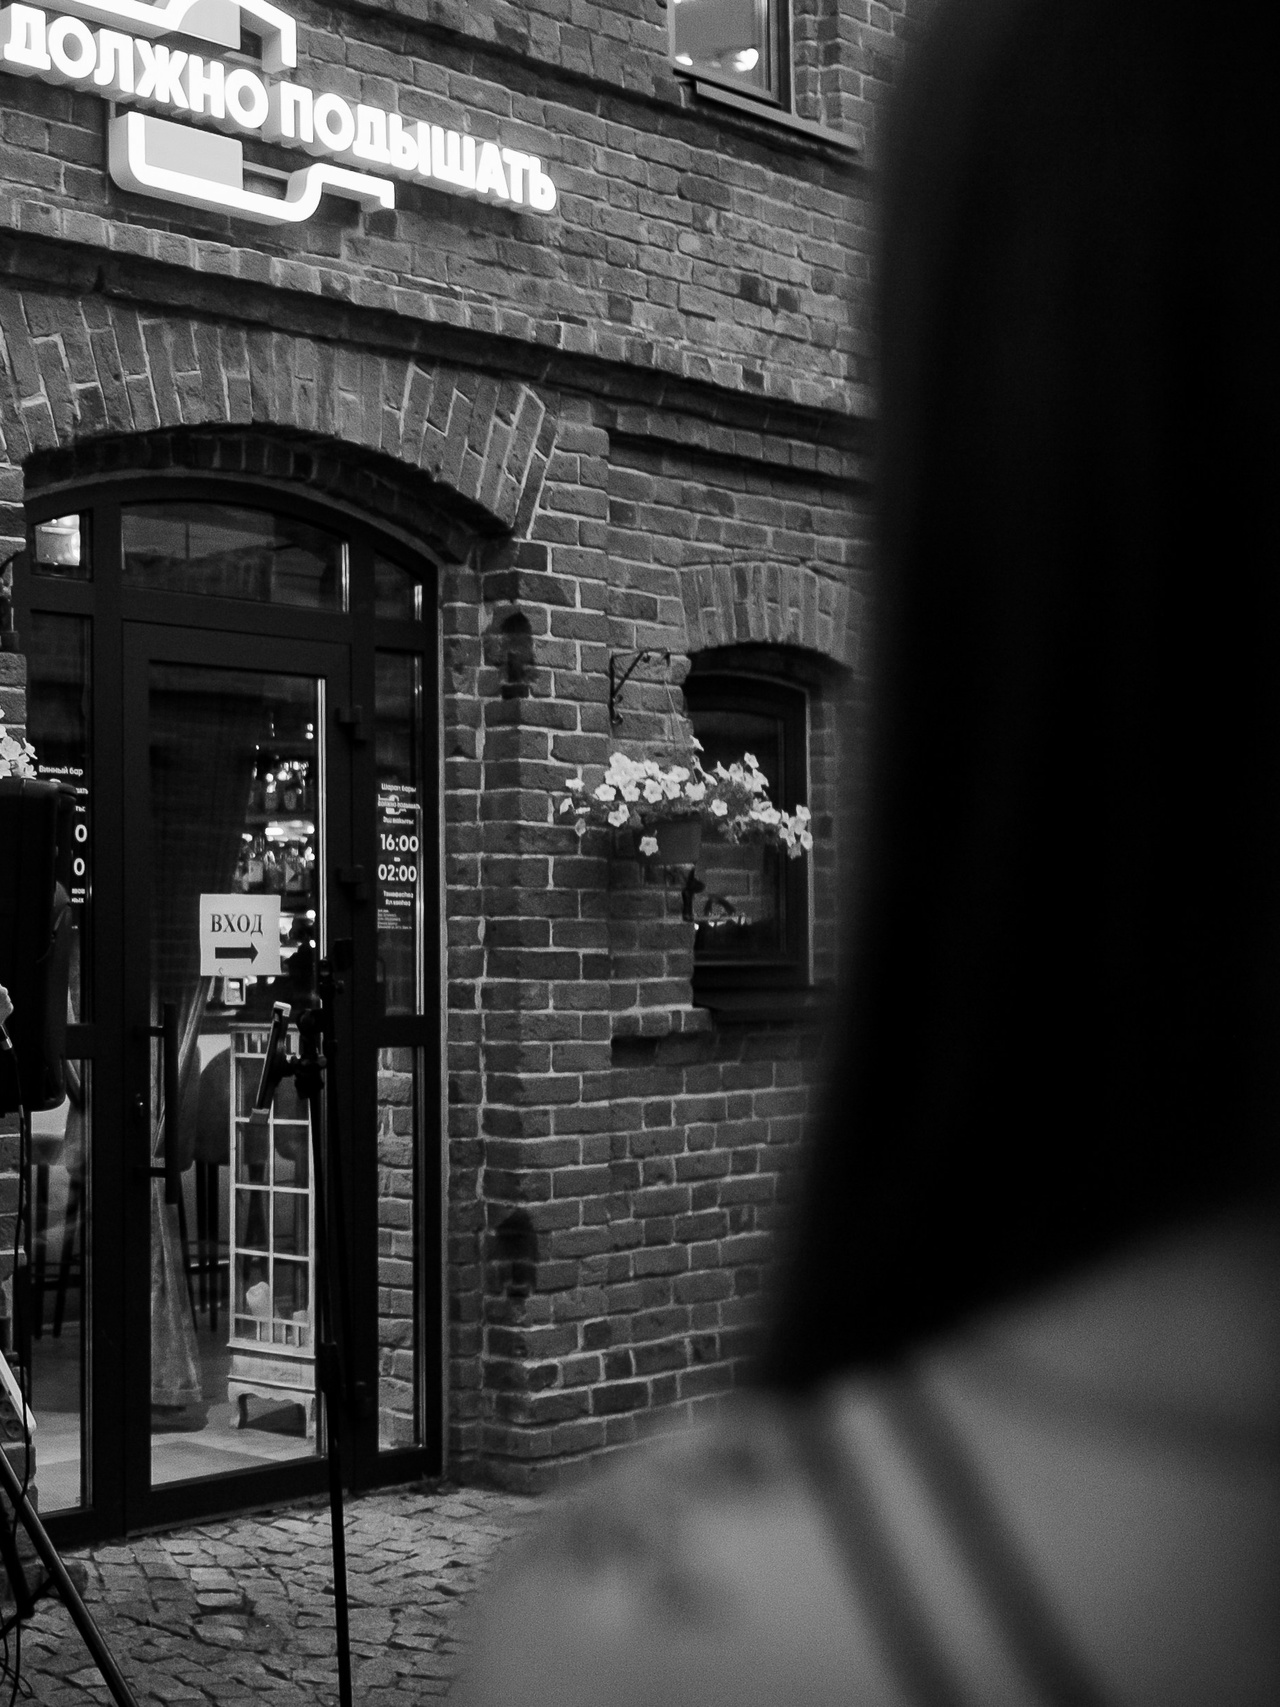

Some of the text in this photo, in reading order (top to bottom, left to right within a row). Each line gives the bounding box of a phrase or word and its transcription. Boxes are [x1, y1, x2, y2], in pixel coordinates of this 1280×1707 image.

[277, 80, 557, 212] ПОДЫШАТЬ
[69, 767, 83, 777] бар
[380, 834, 419, 852] 16:00
[378, 864, 417, 882] 02:00
[210, 913, 264, 937] ВХОД
